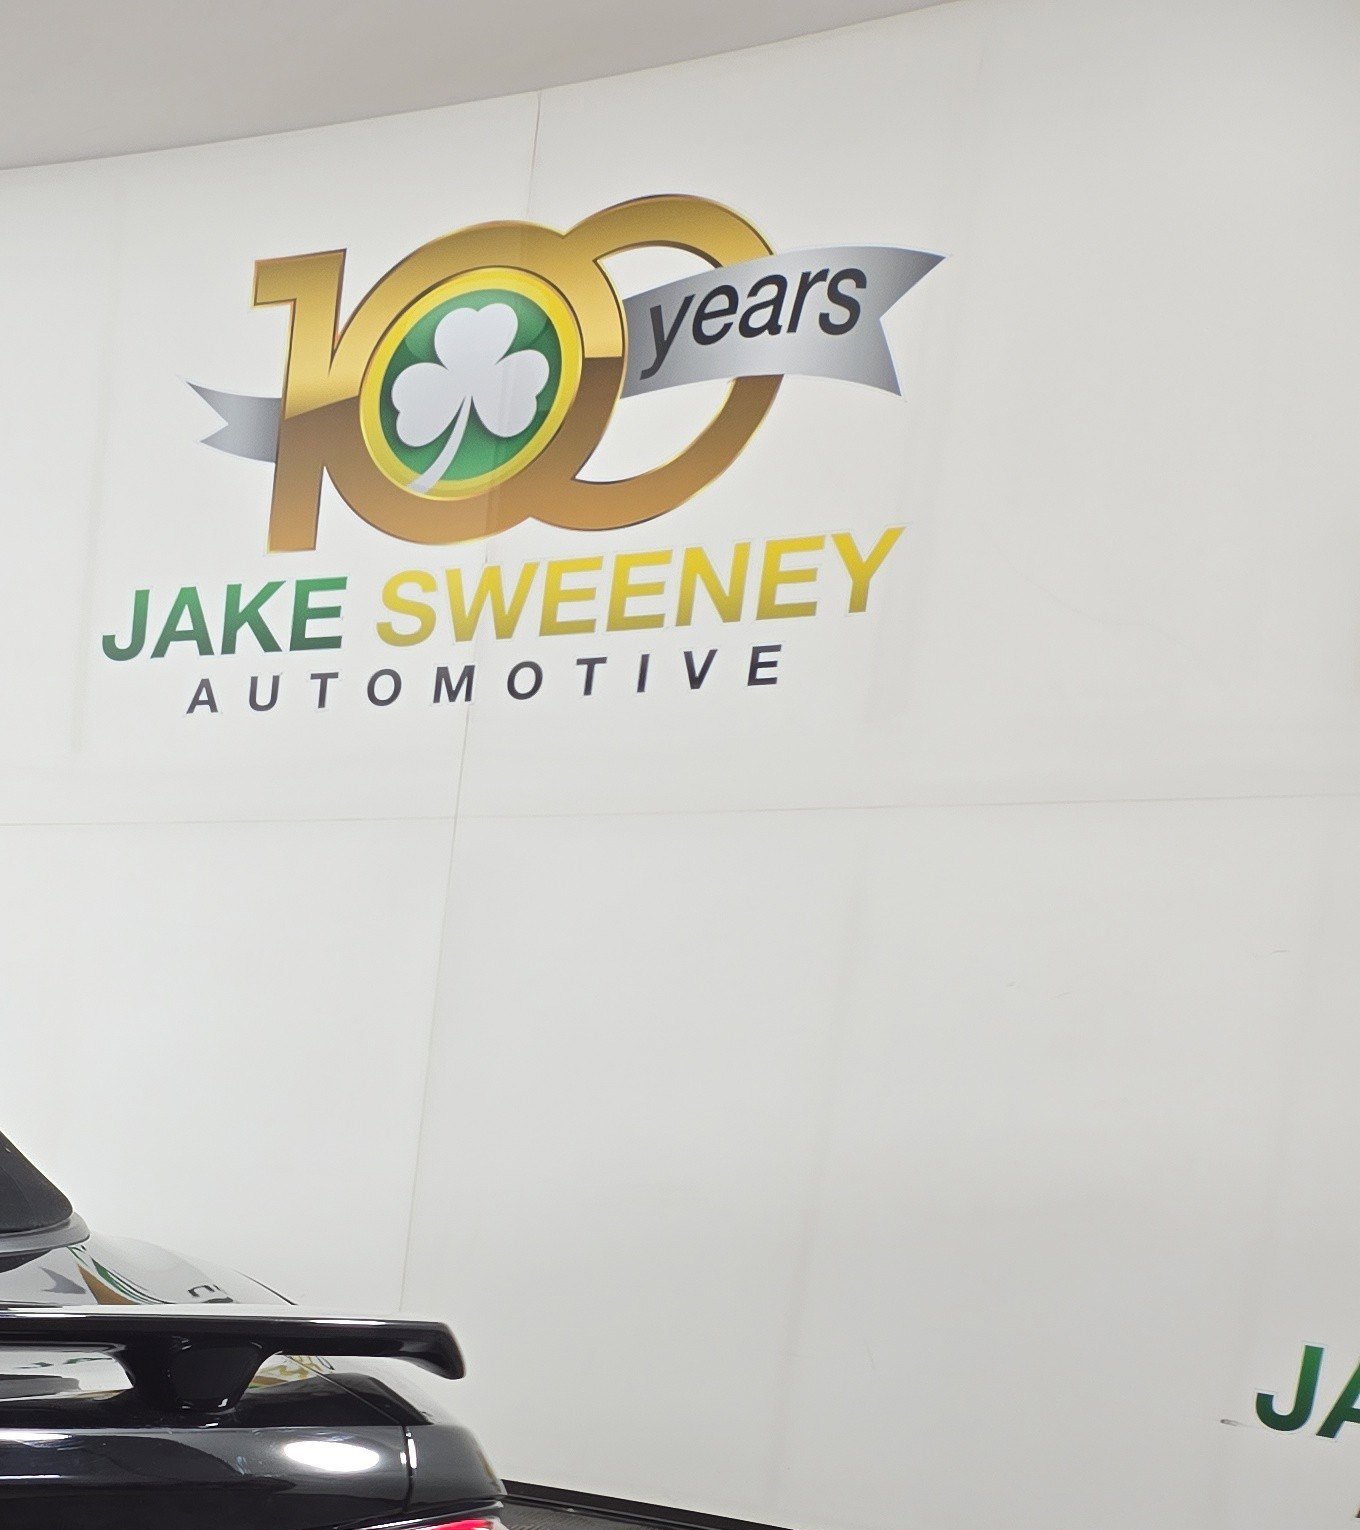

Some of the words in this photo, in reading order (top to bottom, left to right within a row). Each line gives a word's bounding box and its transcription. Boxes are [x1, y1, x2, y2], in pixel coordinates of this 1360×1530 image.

[252, 193, 785, 554] 100
[639, 267, 868, 382] years
[101, 576, 349, 662] JAKE
[375, 526, 907, 648] SWEENEY
[186, 643, 783, 715] AUTOMOTIVE
